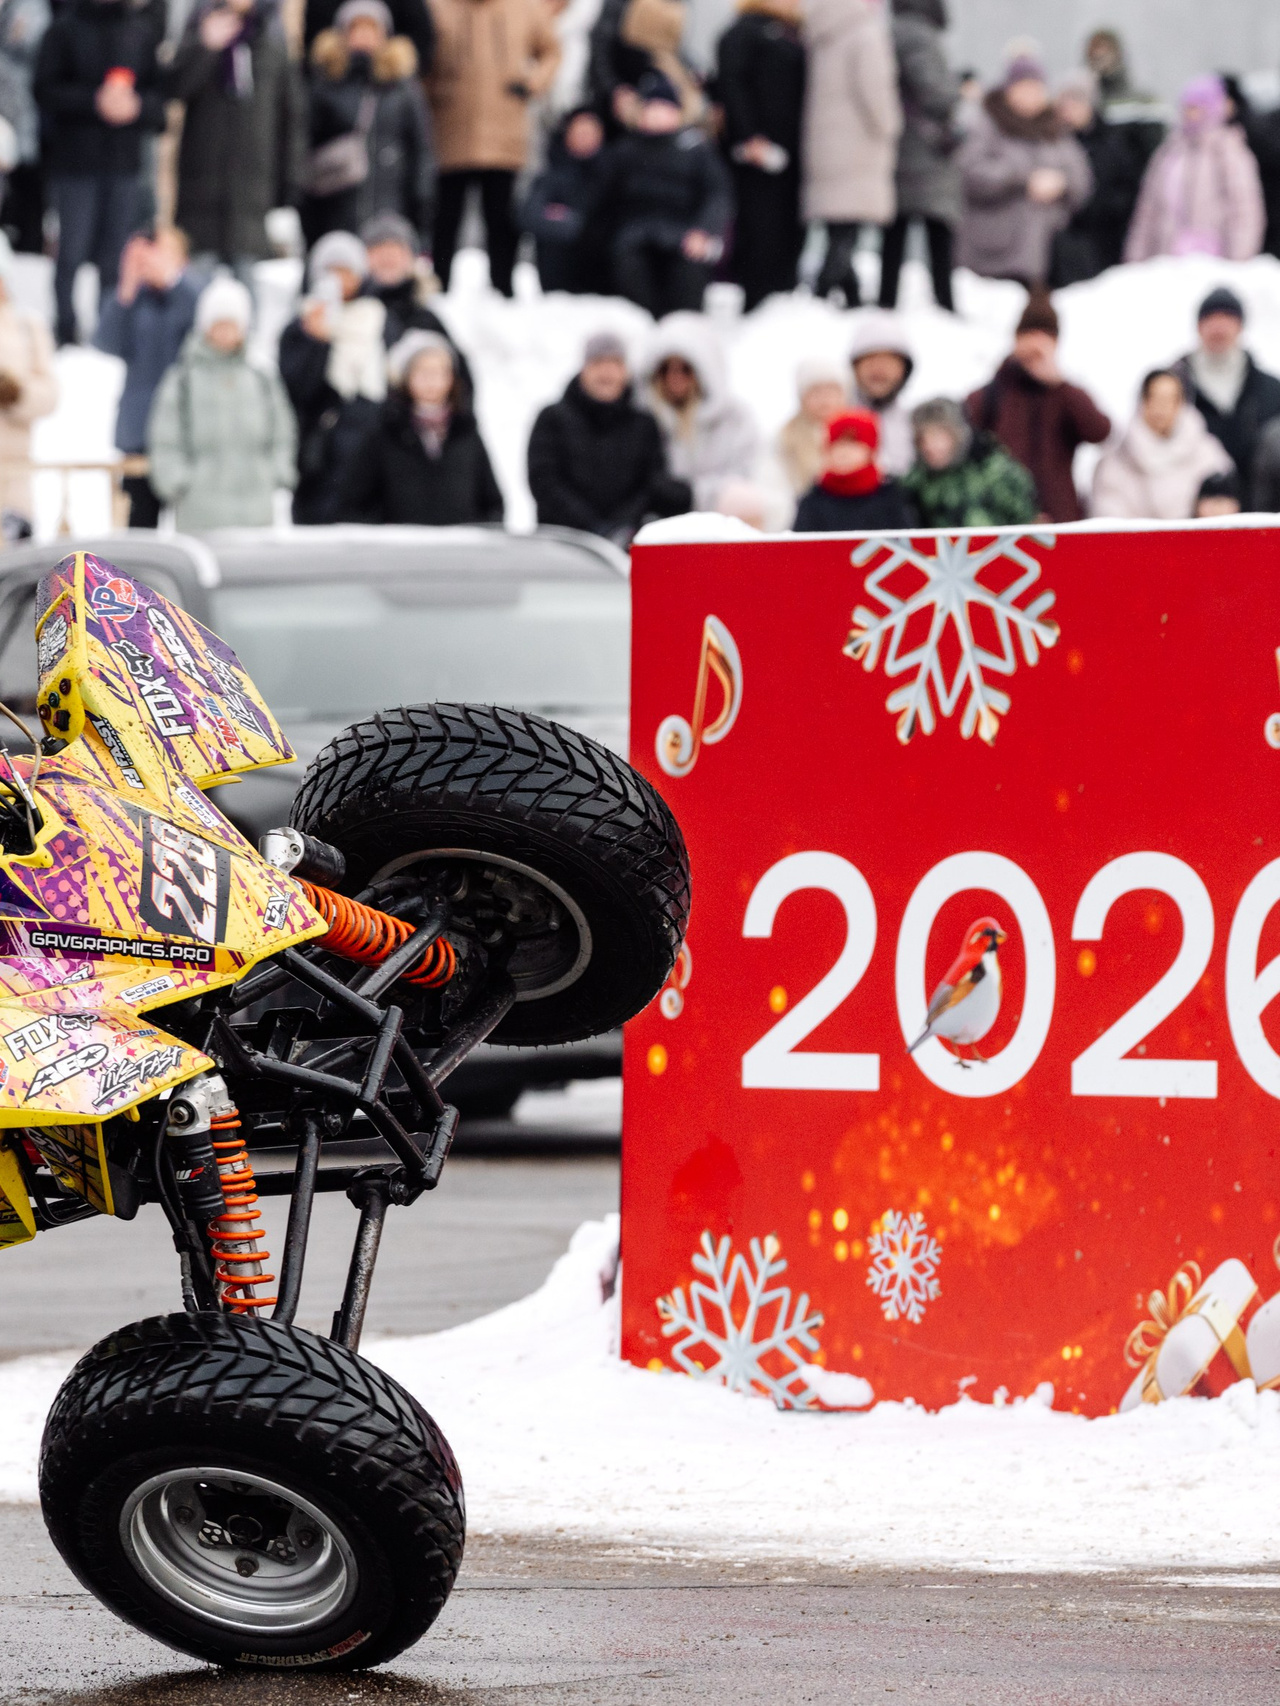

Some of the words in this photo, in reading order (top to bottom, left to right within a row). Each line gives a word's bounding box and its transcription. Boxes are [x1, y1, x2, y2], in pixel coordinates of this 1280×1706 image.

[133, 675, 195, 737] FOX
[203, 697, 243, 750] AMSOIL
[91, 719, 130, 766] FASST
[150, 815, 217, 945] 228
[264, 887, 286, 927] GAV
[31, 932, 211, 963] GAVGRAPHICS.PRO
[125, 979, 166, 997] GoPro
[3, 1014, 70, 1061] FOX
[176, 1167, 205, 1180] WP
